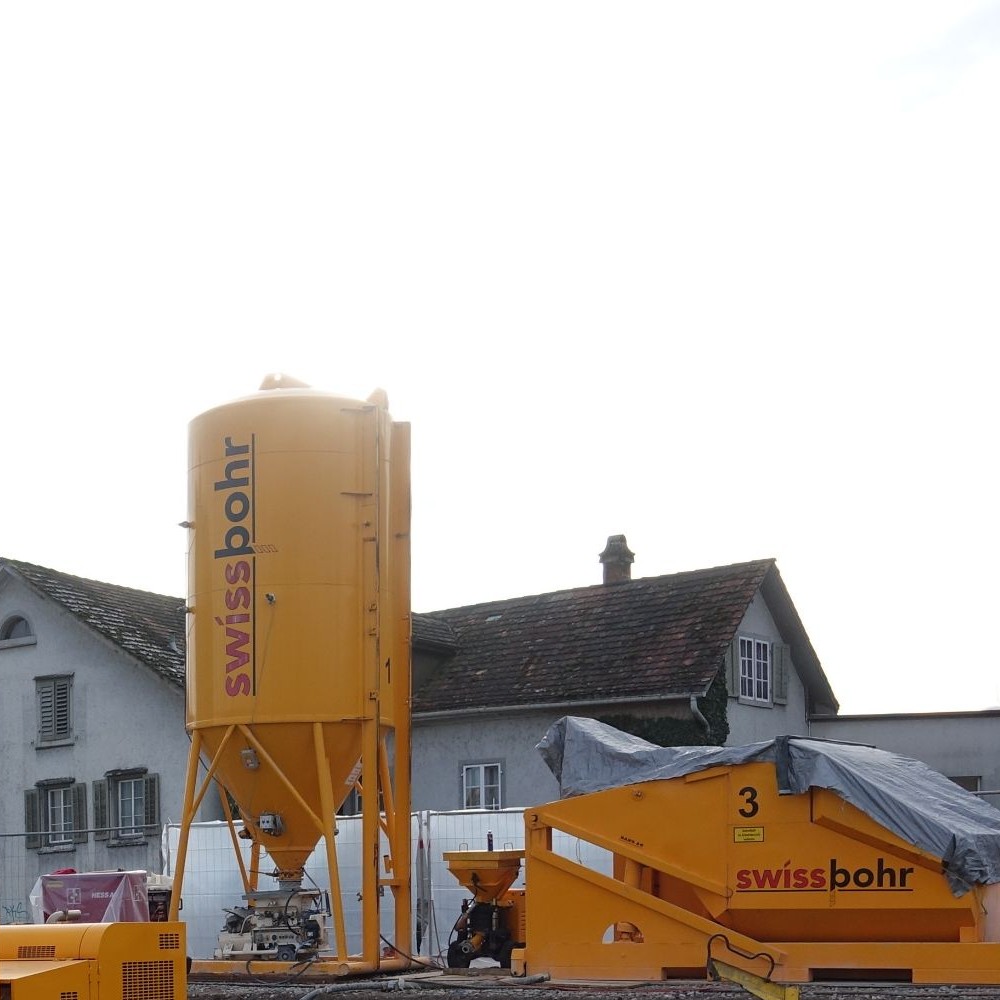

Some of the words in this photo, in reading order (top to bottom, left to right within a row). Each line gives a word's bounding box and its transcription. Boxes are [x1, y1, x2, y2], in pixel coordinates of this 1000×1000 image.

[214, 437, 255, 697] swissbohr
[738, 786, 759, 818] 3
[736, 858, 914, 892] swissbohr
